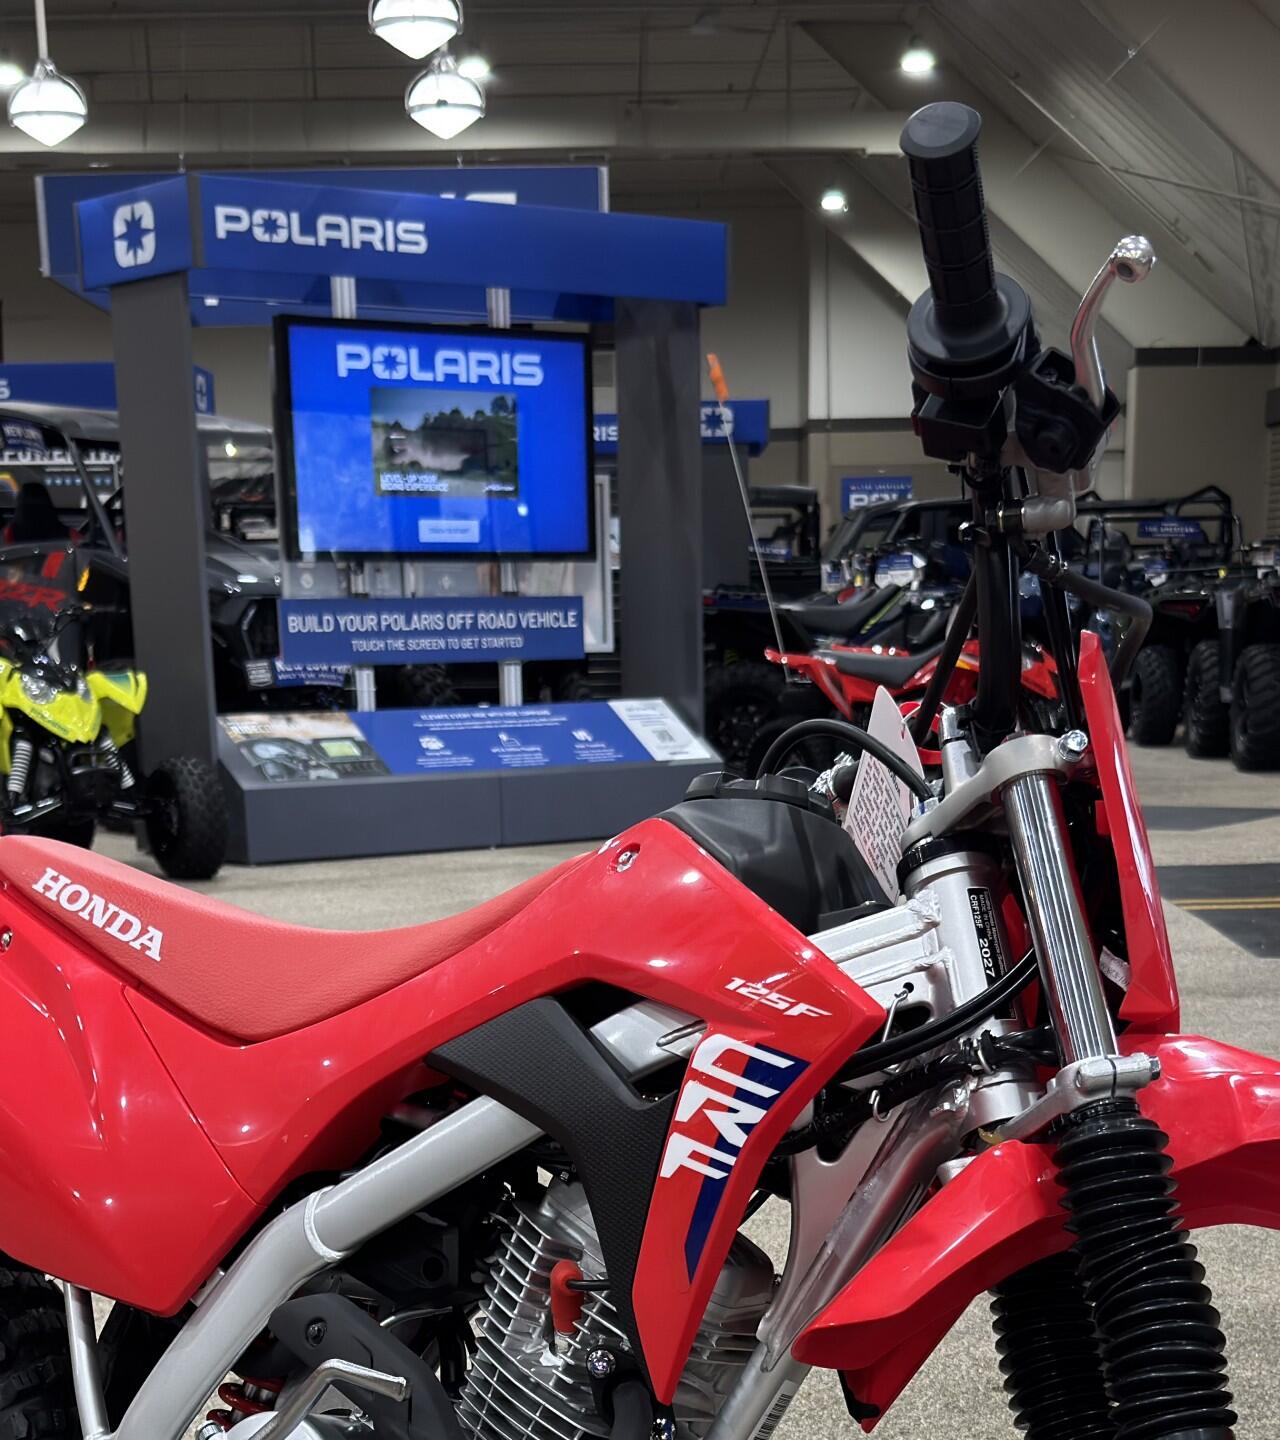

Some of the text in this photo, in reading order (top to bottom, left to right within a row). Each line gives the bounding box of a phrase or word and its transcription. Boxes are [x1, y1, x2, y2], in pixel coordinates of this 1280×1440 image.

[214, 205, 428, 255] POLARIS
[336, 343, 545, 387] POLARIS
[287, 610, 577, 633] BUILD YOUR POLARIS OFF ROAD VEHICLE
[351, 637, 523, 651] TOUCH THE SCREEN TO GET STARTED
[31, 867, 164, 962] HONDA
[970, 894, 995, 978] CRF125F 2027
[985, 921, 993, 940] CHINA
[724, 976, 833, 1017] 125F
[659, 1033, 796, 1180] CRF
